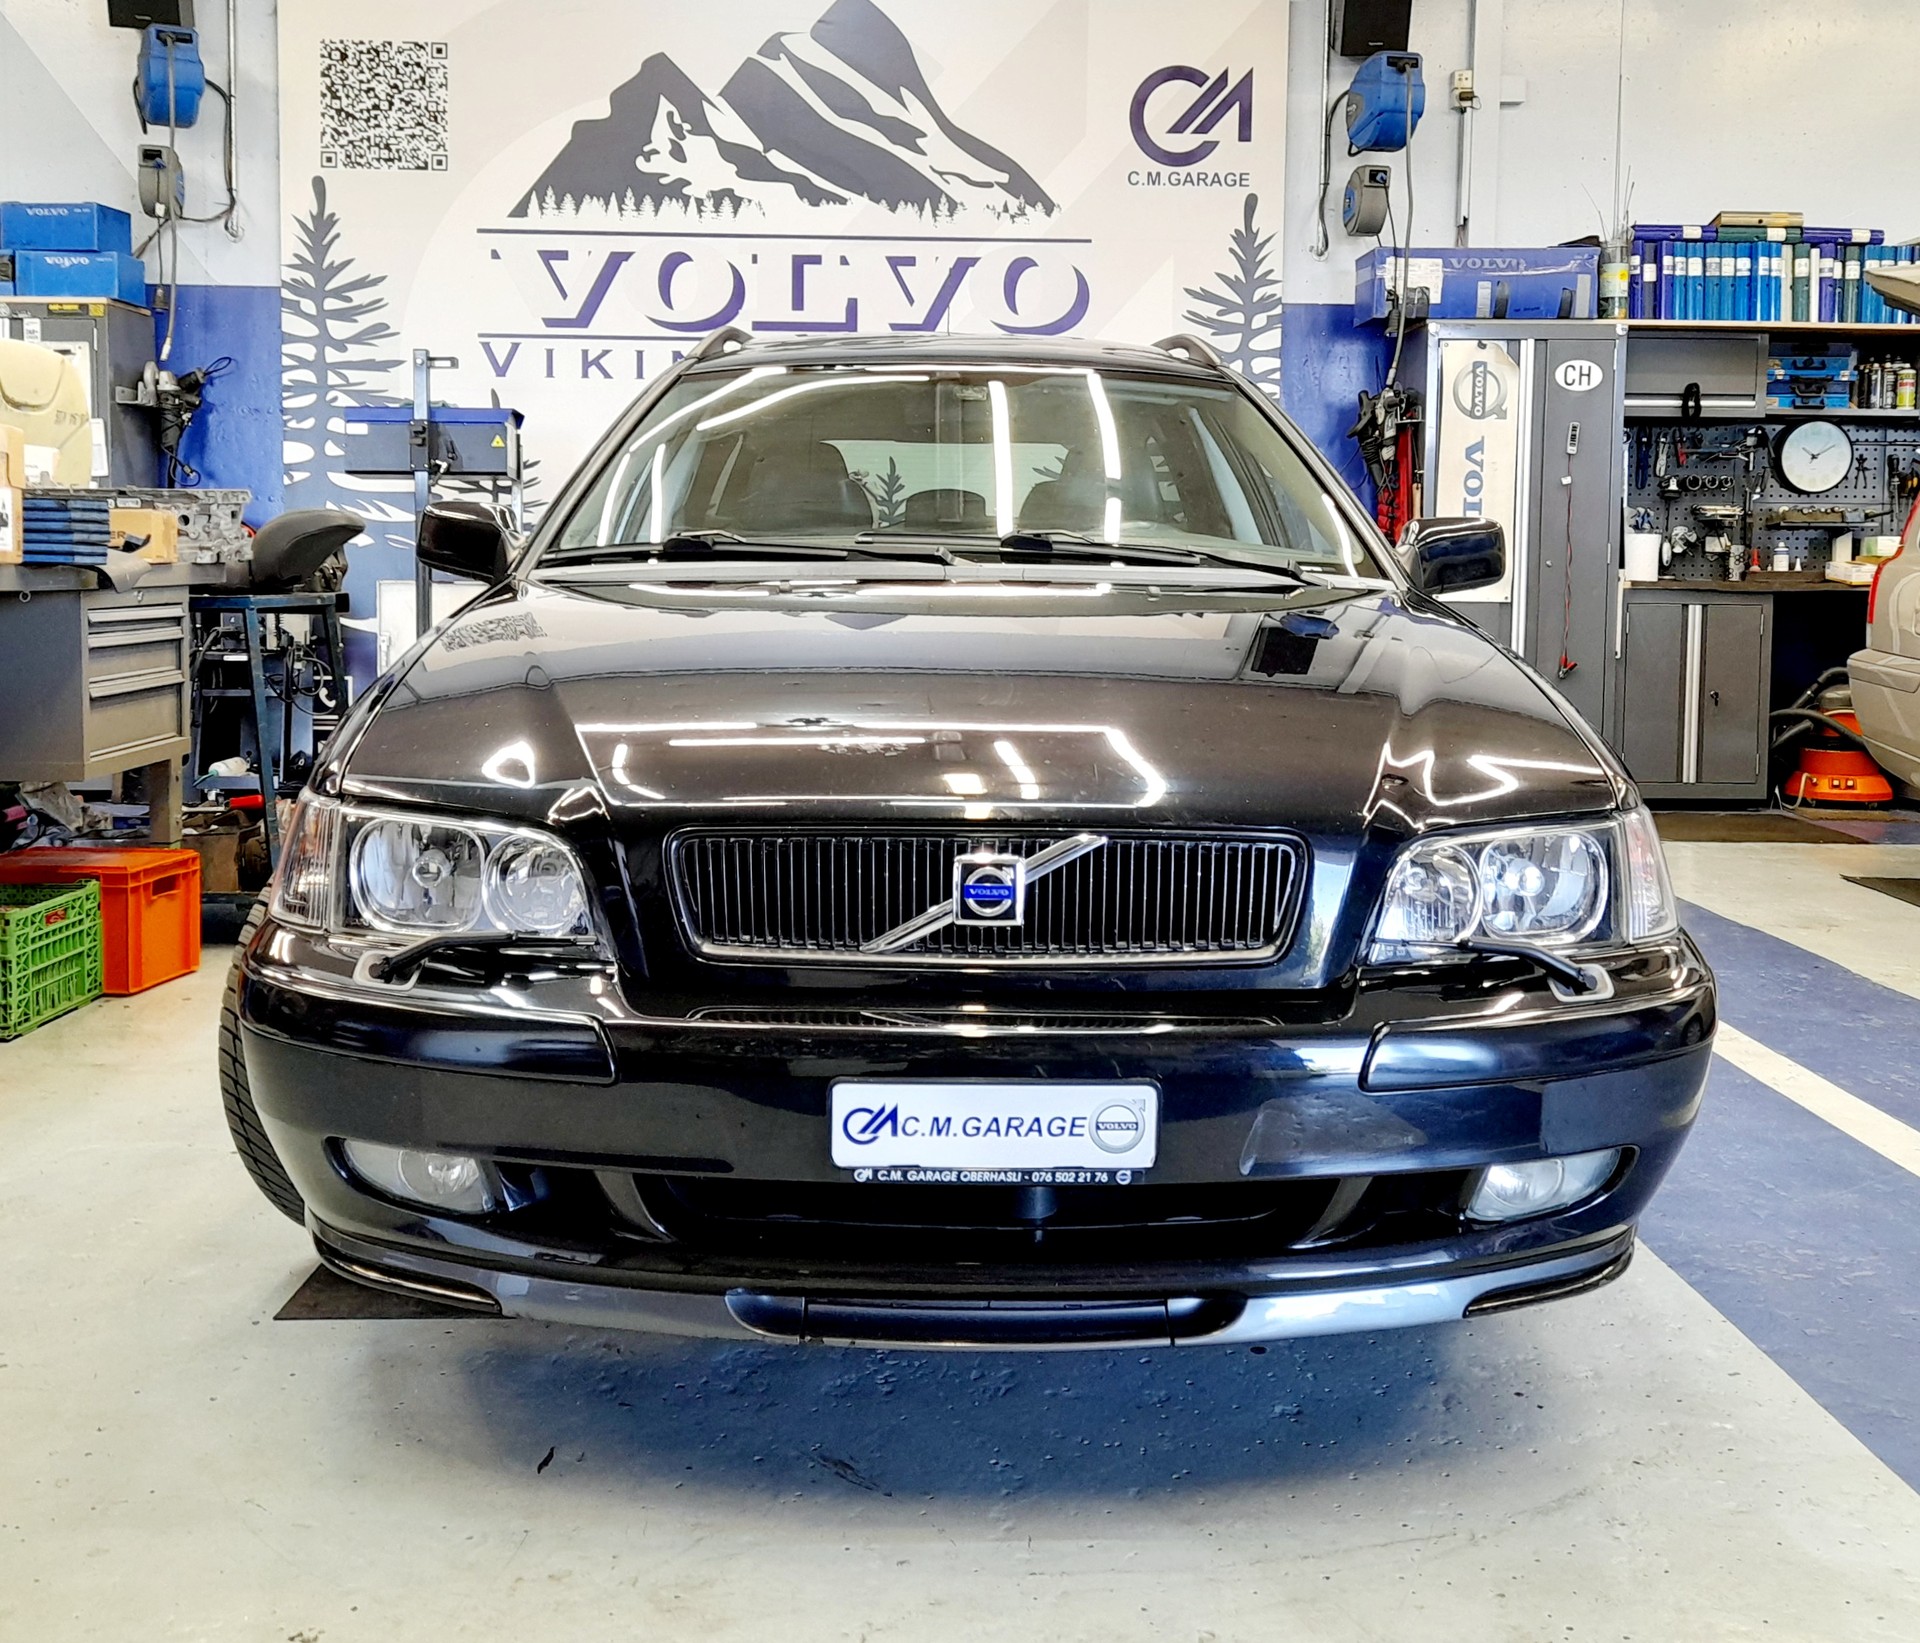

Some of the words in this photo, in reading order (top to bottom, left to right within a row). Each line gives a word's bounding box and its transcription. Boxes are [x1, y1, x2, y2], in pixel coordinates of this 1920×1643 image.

[1127, 170, 1250, 187] C.M.GARAGE
[490, 246, 1090, 335] VOLVO
[1564, 364, 1592, 387] CH
[1473, 364, 1485, 416] VOLVO
[1463, 435, 1485, 518] VOL
[969, 888, 1009, 896] VOLVO
[901, 1116, 1087, 1137] C.M.GARAGE
[877, 1170, 904, 1181] C.M.
[906, 1170, 958, 1182] GARAGE
[960, 1171, 1022, 1183] OBERHASLI
[1031, 1172, 1053, 1183] 076
[1054, 1172, 1076, 1183] 502
[1077, 1172, 1092, 1182] 21
[1094, 1172, 1109, 1183] 76
